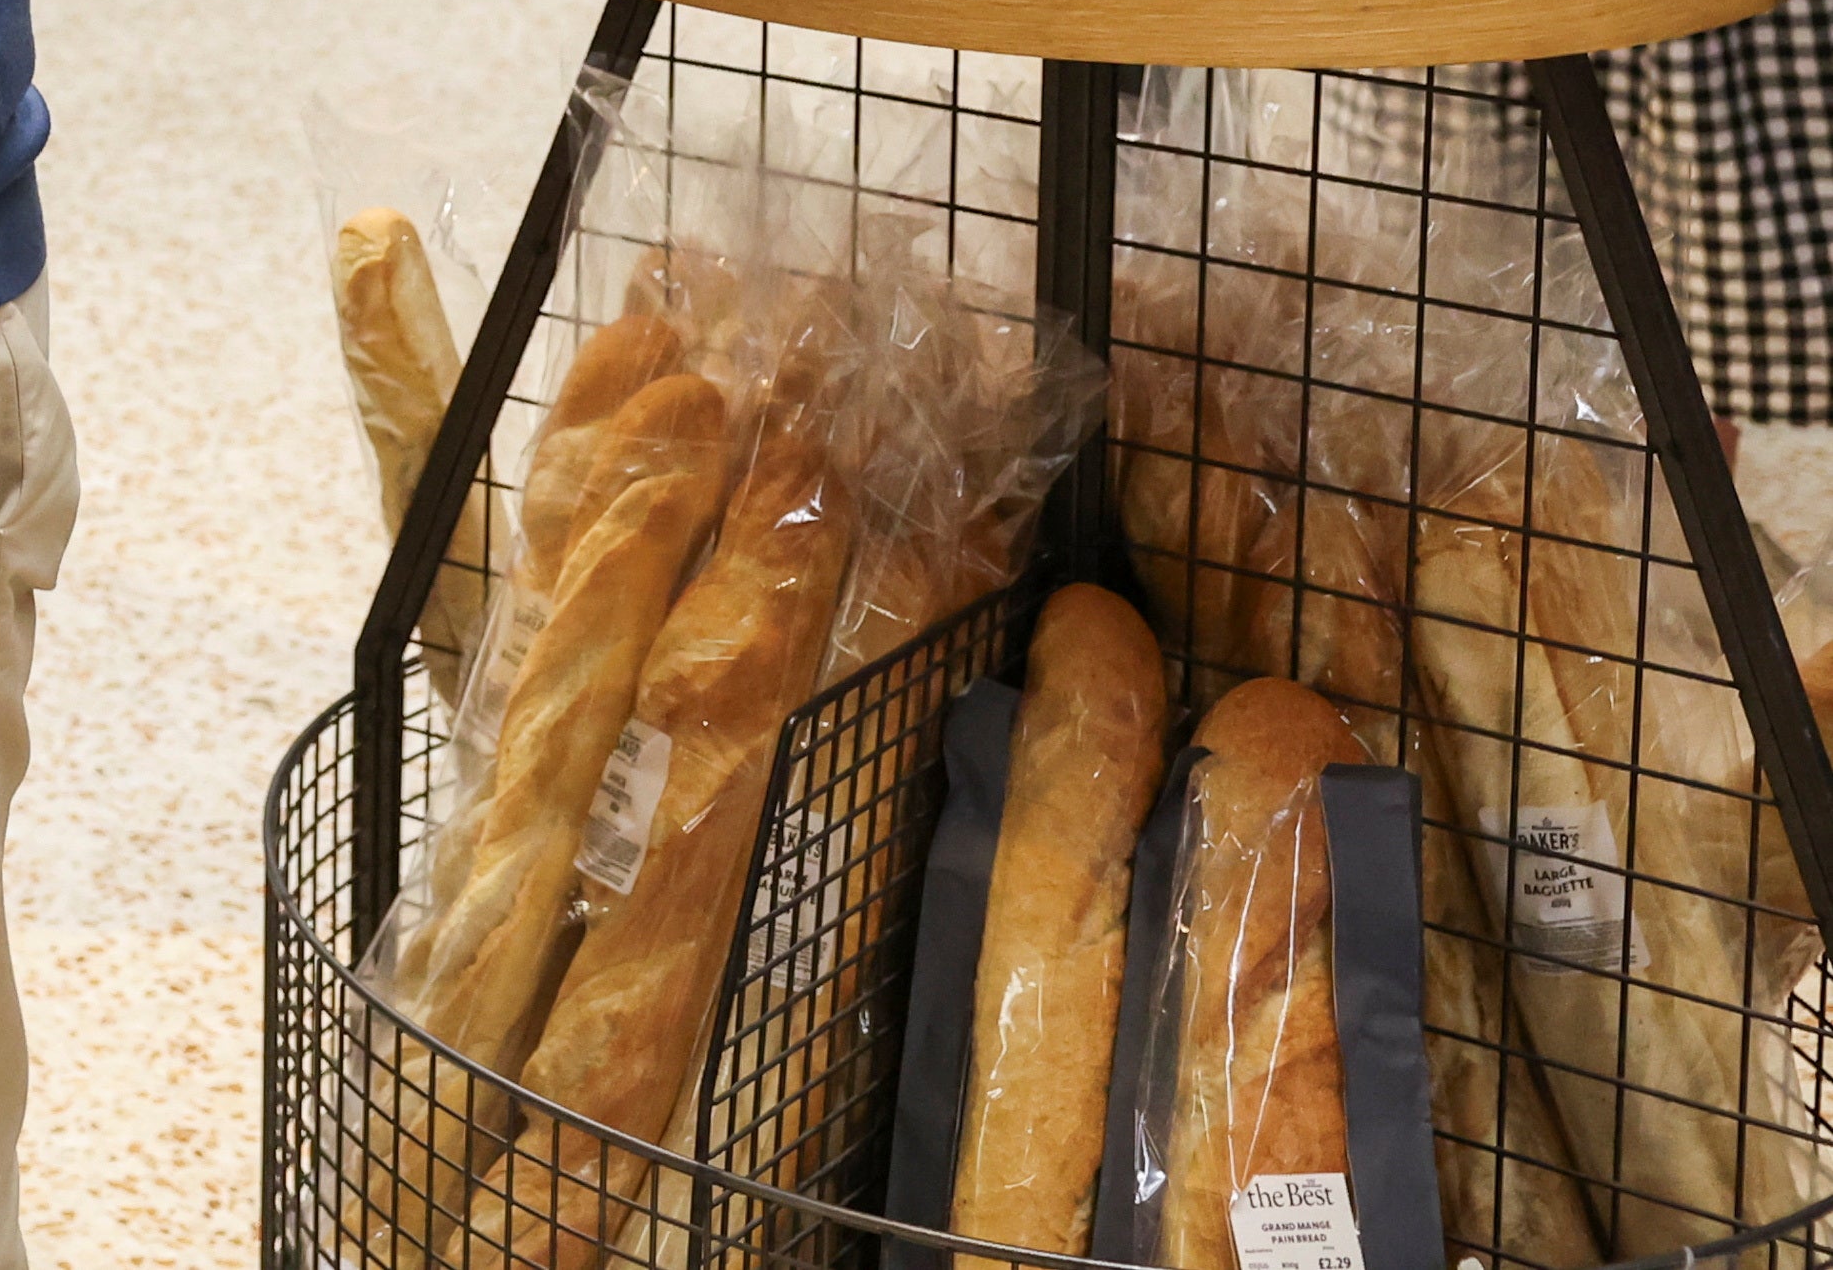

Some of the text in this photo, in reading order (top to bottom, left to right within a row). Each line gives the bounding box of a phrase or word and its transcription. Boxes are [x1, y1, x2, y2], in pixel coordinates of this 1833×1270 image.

[1517, 833, 1581, 851] BAKER'S
[1534, 864, 1578, 882] LARGE
[1523, 876, 1595, 897] BAGUETTE
[1247, 1182, 1335, 1209] the Best
[1261, 1220, 1332, 1232] GRAND MANGE
[1271, 1234, 1327, 1244] PAIN BREAD
[1318, 1256, 1352, 1270] £2.29
